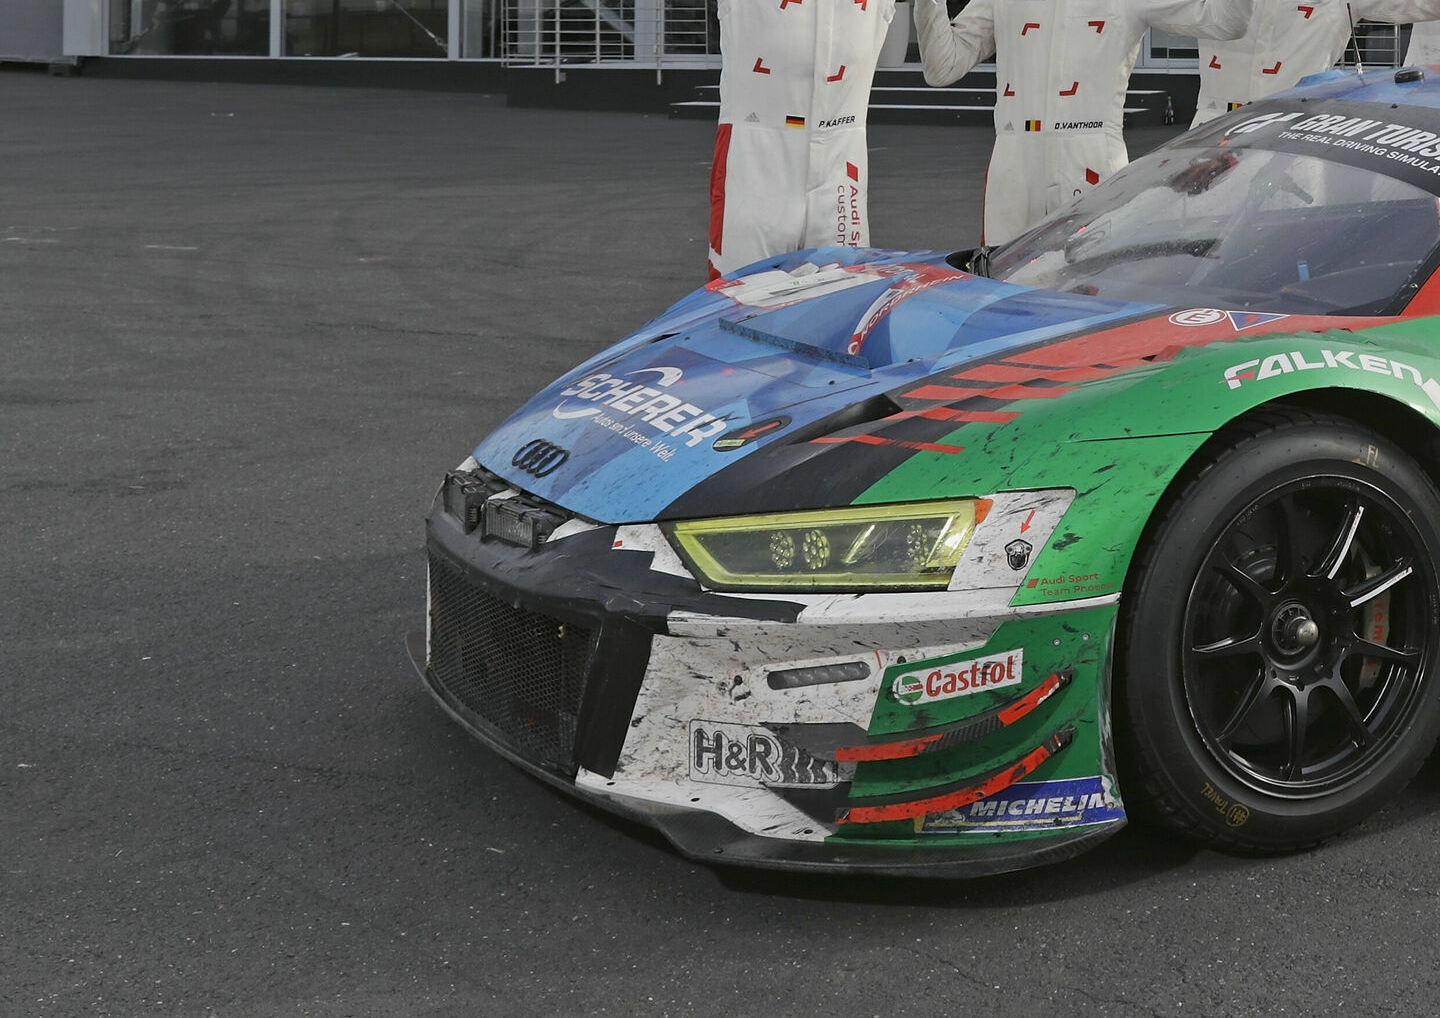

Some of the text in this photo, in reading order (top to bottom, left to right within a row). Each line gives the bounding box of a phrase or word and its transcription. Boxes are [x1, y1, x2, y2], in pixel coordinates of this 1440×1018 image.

[1290, 114, 1369, 140] GRAN
[1278, 131, 1301, 141] THE
[1301, 134, 1332, 145] REAL
[1335, 138, 1386, 157] DRIVING
[850, 185, 860, 225] Audi
[1223, 349, 1425, 390] FALKEN
[560, 373, 728, 448] SCHERER
[1041, 572, 1100, 586] Audi Sport
[1041, 587, 1071, 597] Team
[926, 655, 1016, 697] Castrol
[694, 727, 782, 779] H&R
[971, 792, 1104, 817] MICHELIN
